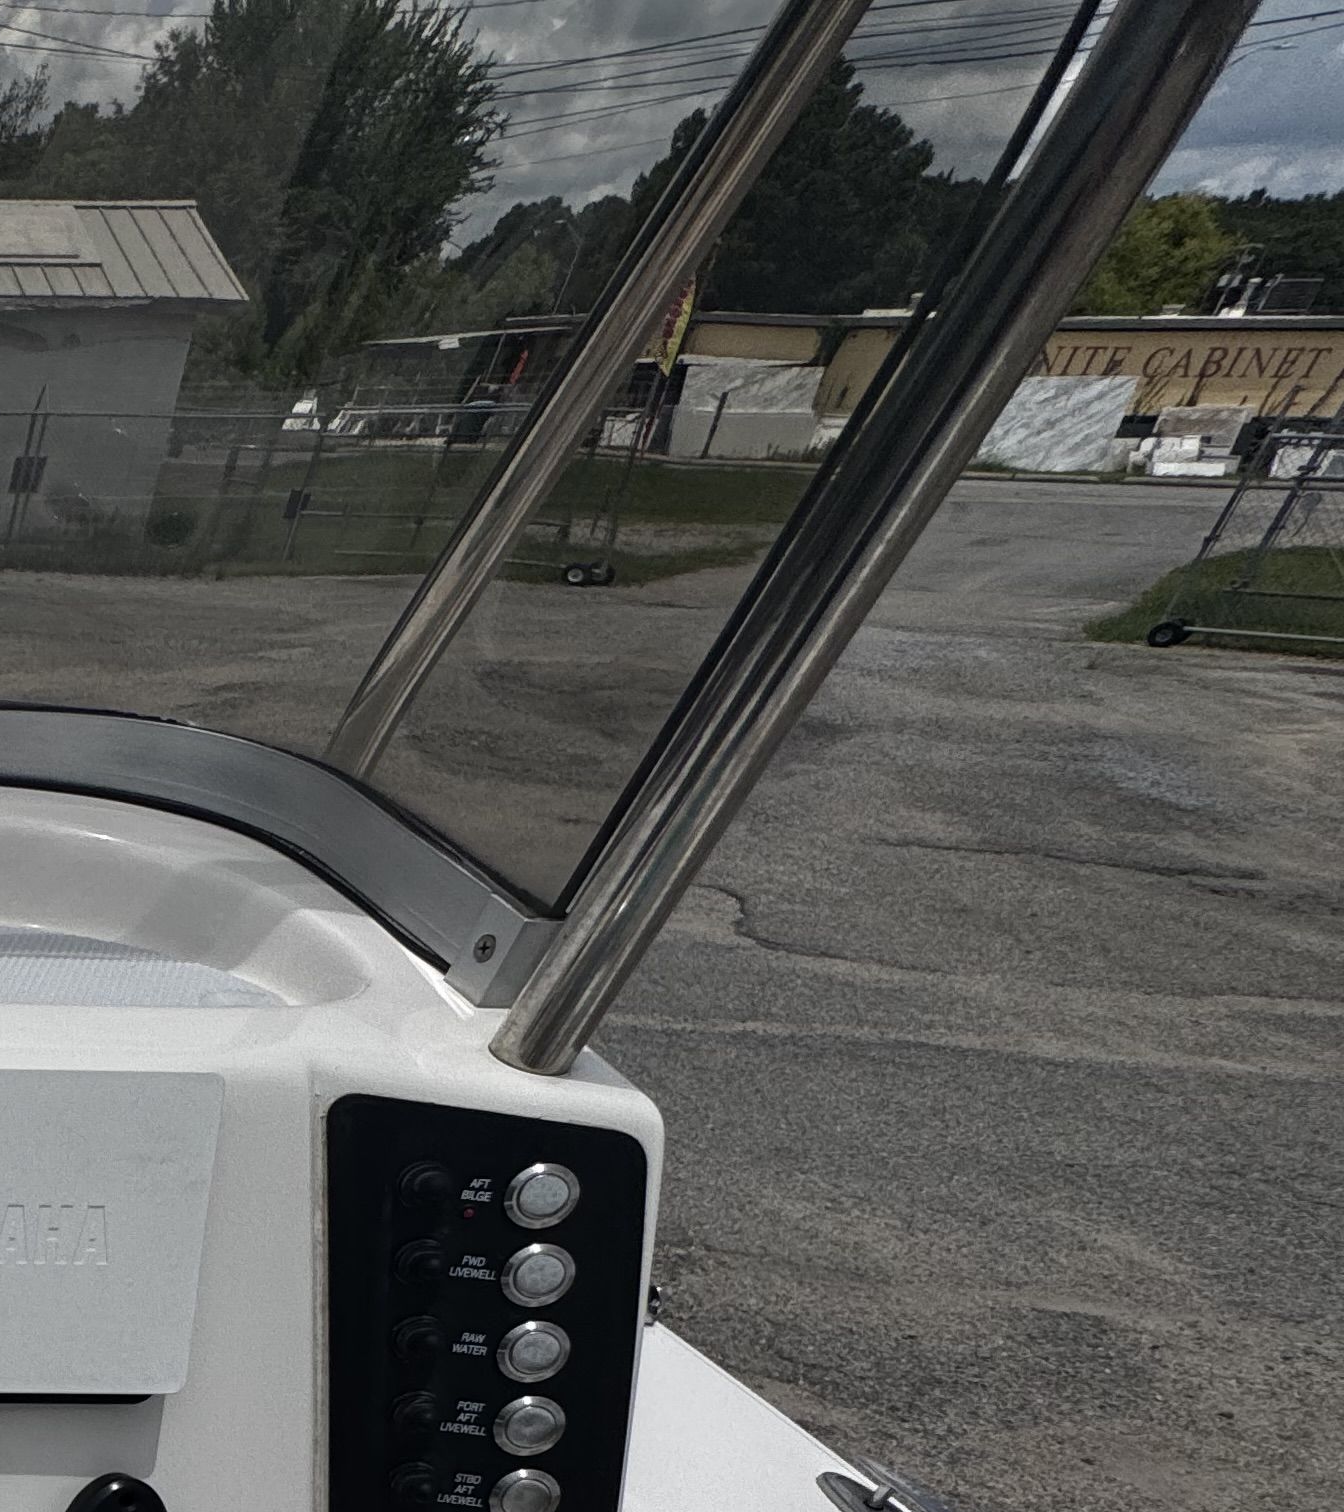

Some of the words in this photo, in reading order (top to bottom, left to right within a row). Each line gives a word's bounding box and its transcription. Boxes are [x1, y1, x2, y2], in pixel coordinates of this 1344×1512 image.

[1028, 345, 1132, 377] NITE
[1142, 346, 1334, 379] CABINET
[469, 1178, 492, 1189] AFT
[460, 1189, 493, 1202] BILGE
[462, 1255, 486, 1267] FWD
[448, 1267, 497, 1281] LIVEWELL
[461, 1332, 486, 1343] RAW
[451, 1344, 488, 1356] WATER
[456, 1400, 486, 1413] PORT
[456, 1412, 478, 1424] AFT
[439, 1422, 487, 1437] LIVEWELL
[454, 1473, 481, 1485] STBD
[453, 1484, 475, 1495] AFT
[437, 1493, 484, 1508] LIVEWELL
